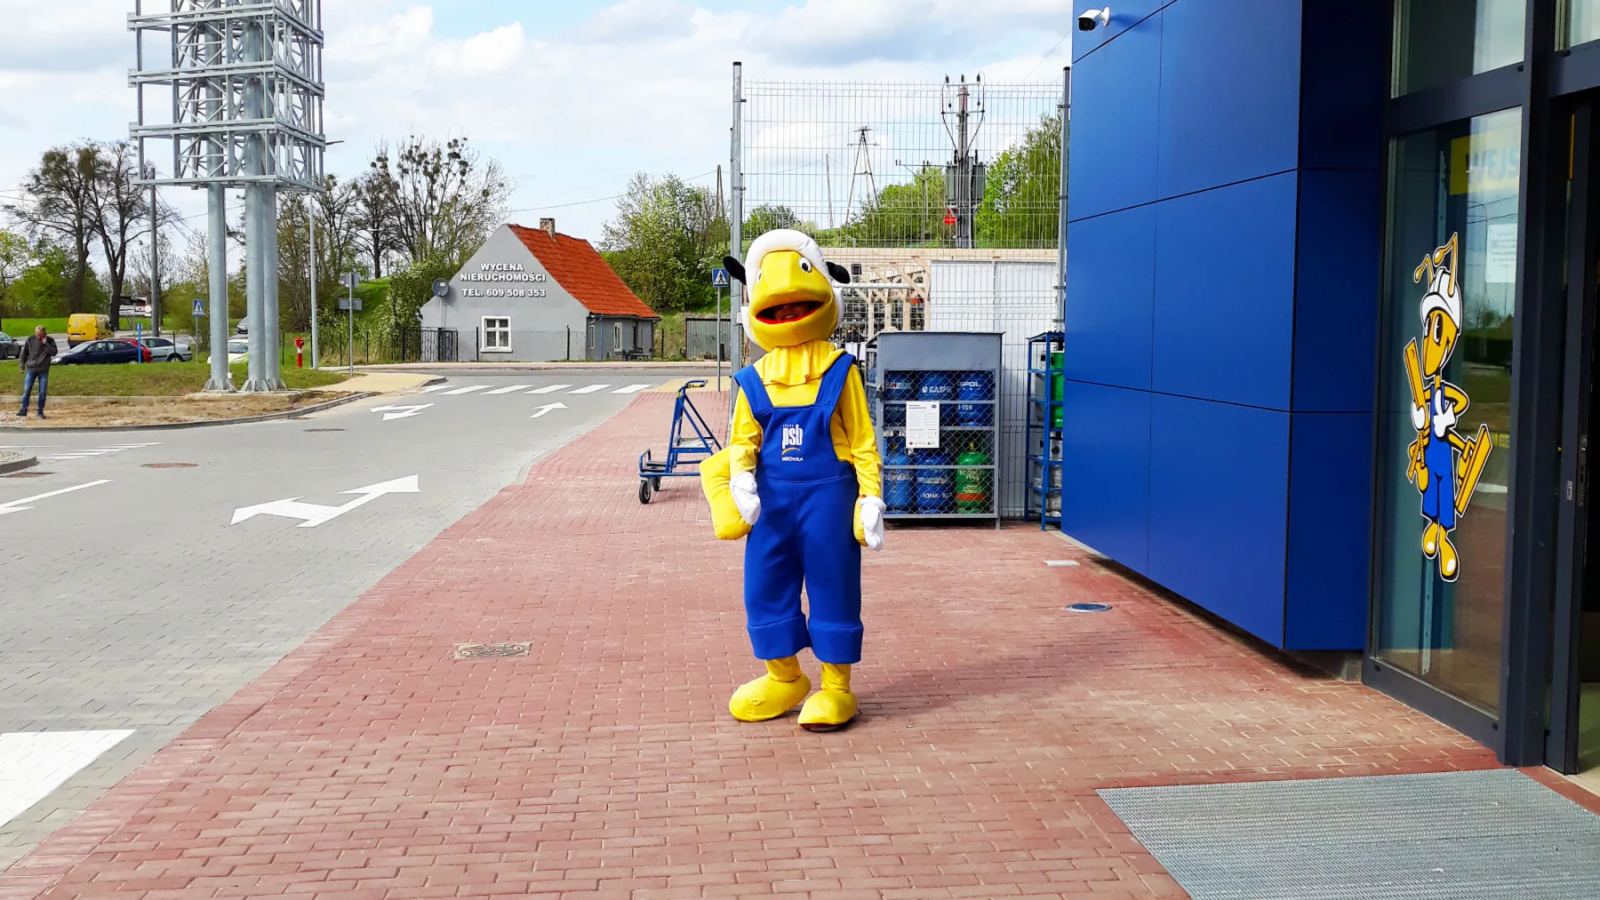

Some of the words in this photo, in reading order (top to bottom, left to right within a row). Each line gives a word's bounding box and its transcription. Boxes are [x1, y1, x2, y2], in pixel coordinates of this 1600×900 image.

[480, 263, 524, 271] WYCENA
[460, 272, 546, 282] NIERUCHOMOŚCI
[462, 288, 484, 297] TEL.
[486, 288, 505, 297] 609
[507, 288, 525, 297] 508
[527, 288, 546, 297] 353
